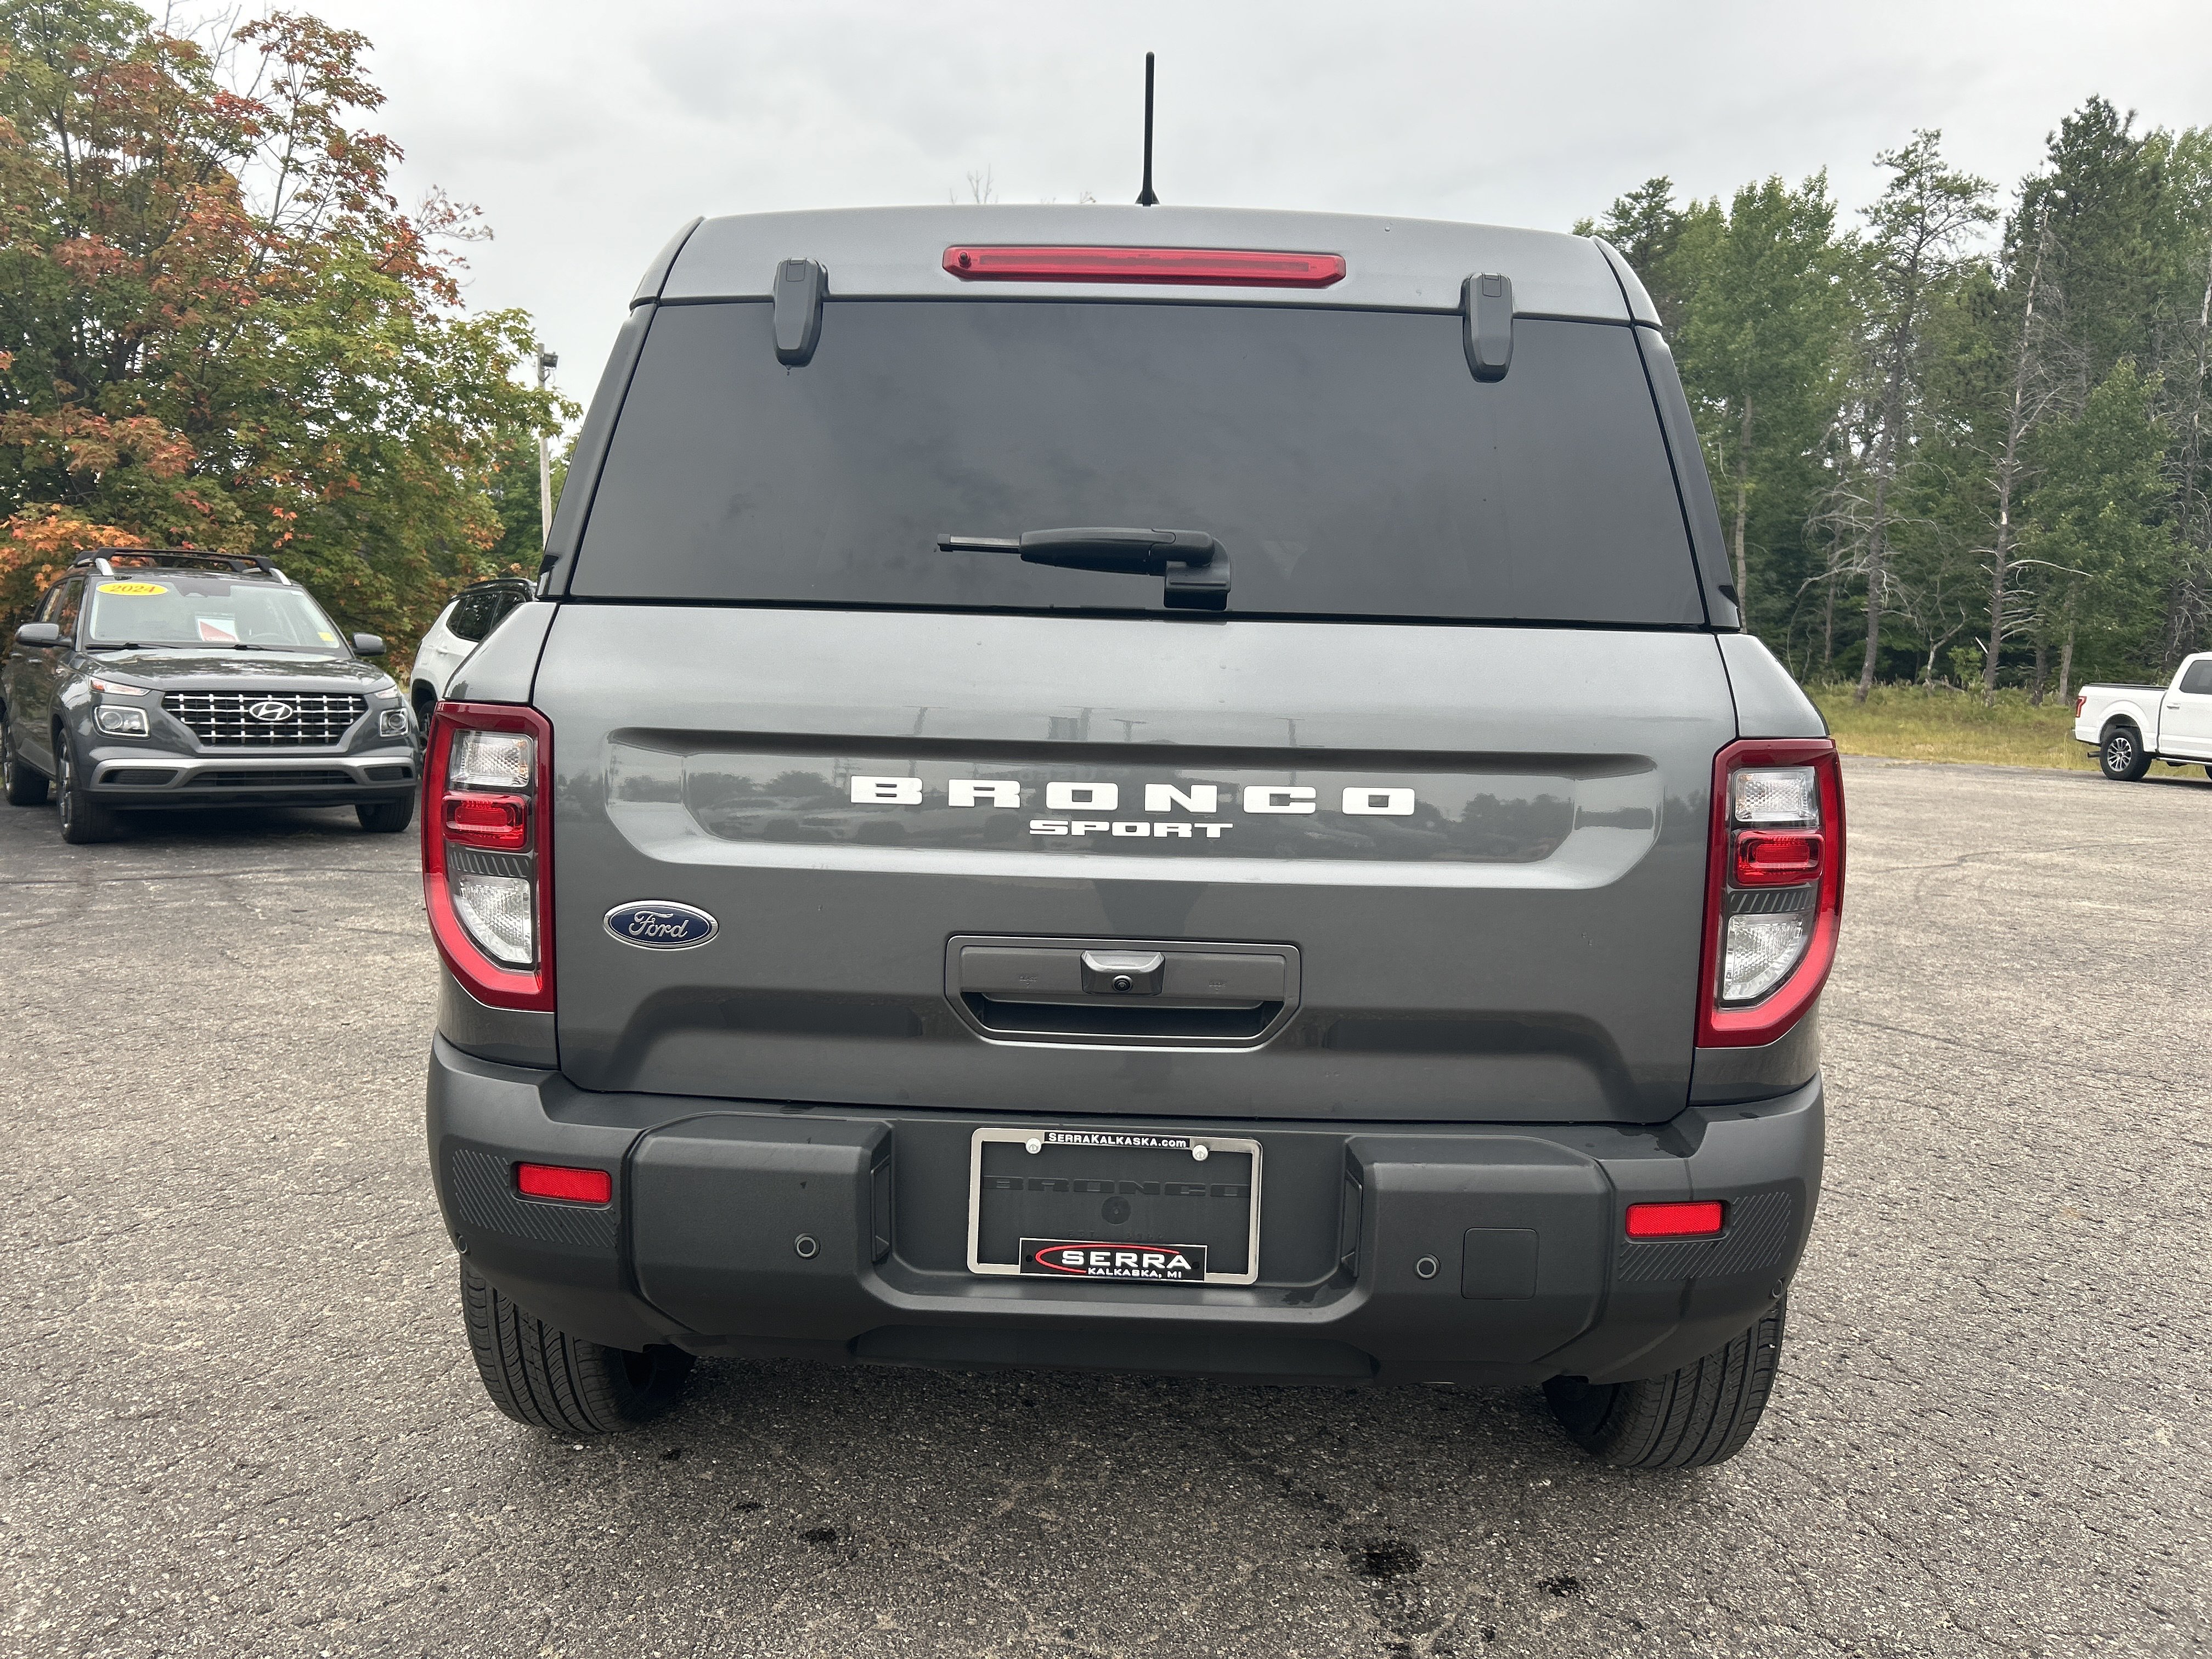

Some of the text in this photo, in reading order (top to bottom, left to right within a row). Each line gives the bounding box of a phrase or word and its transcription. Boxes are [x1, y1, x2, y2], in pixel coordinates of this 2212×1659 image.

[850, 775, 1415, 815] BRONCO
[1029, 819, 1233, 838] SPORT
[629, 911, 689, 938] Ford
[1048, 1132, 1187, 1148] SERRAKALKASKA.com
[983, 1175, 1251, 1198] BRONCO
[1062, 1250, 1192, 1269] SERRA
[1088, 1267, 1162, 1278] KALKASKA,
